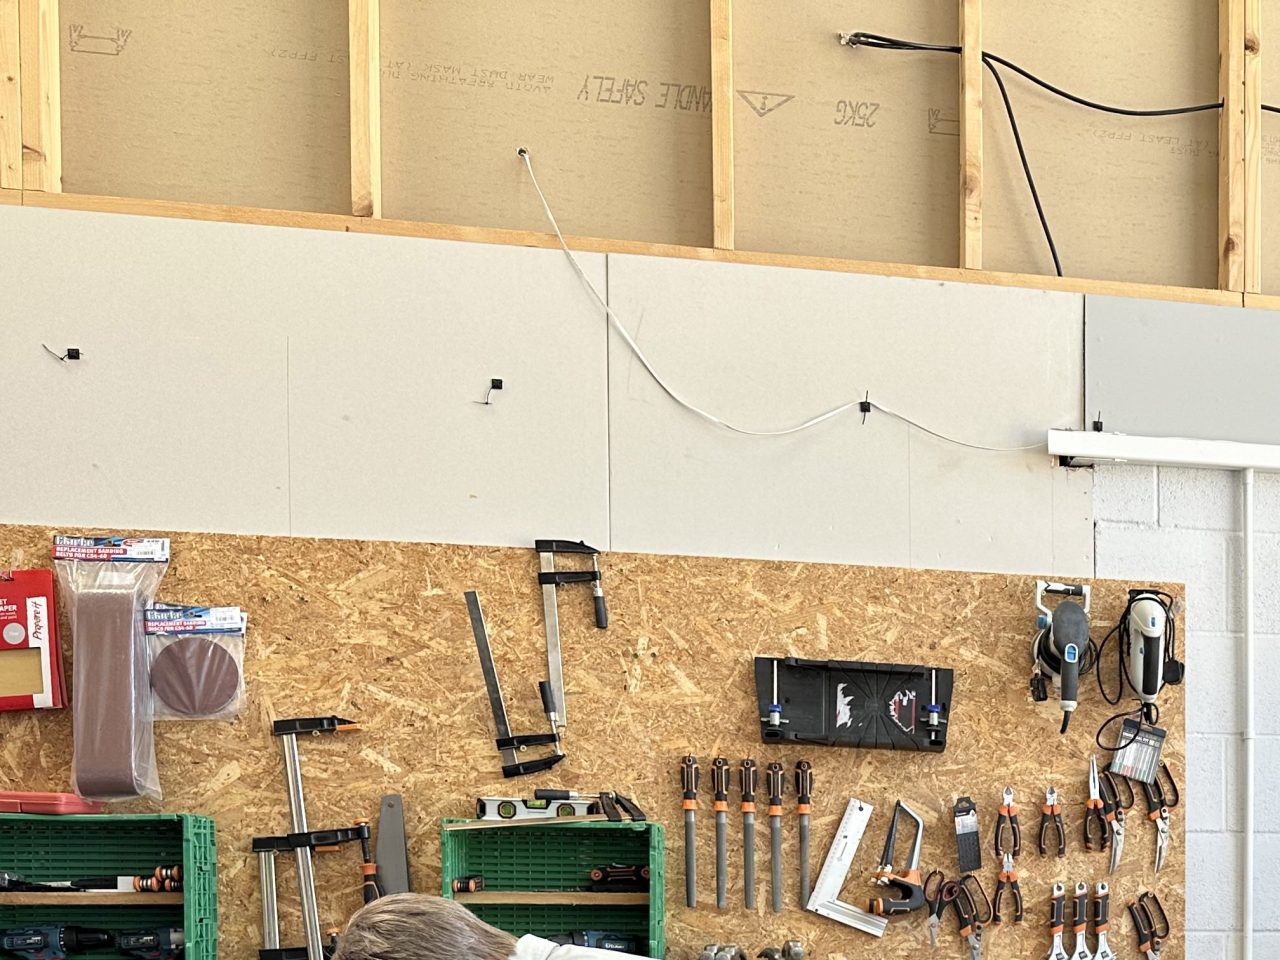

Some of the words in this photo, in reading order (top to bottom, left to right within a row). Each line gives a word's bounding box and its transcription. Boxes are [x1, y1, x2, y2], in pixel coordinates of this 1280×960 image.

[424, 62, 461, 75] MASK
[472, 67, 508, 81] DUST
[517, 72, 555, 84] WEAR
[577, 74, 648, 106] SAFELY
[655, 82, 713, 112] ANDLE
[833, 99, 880, 128] 25KG
